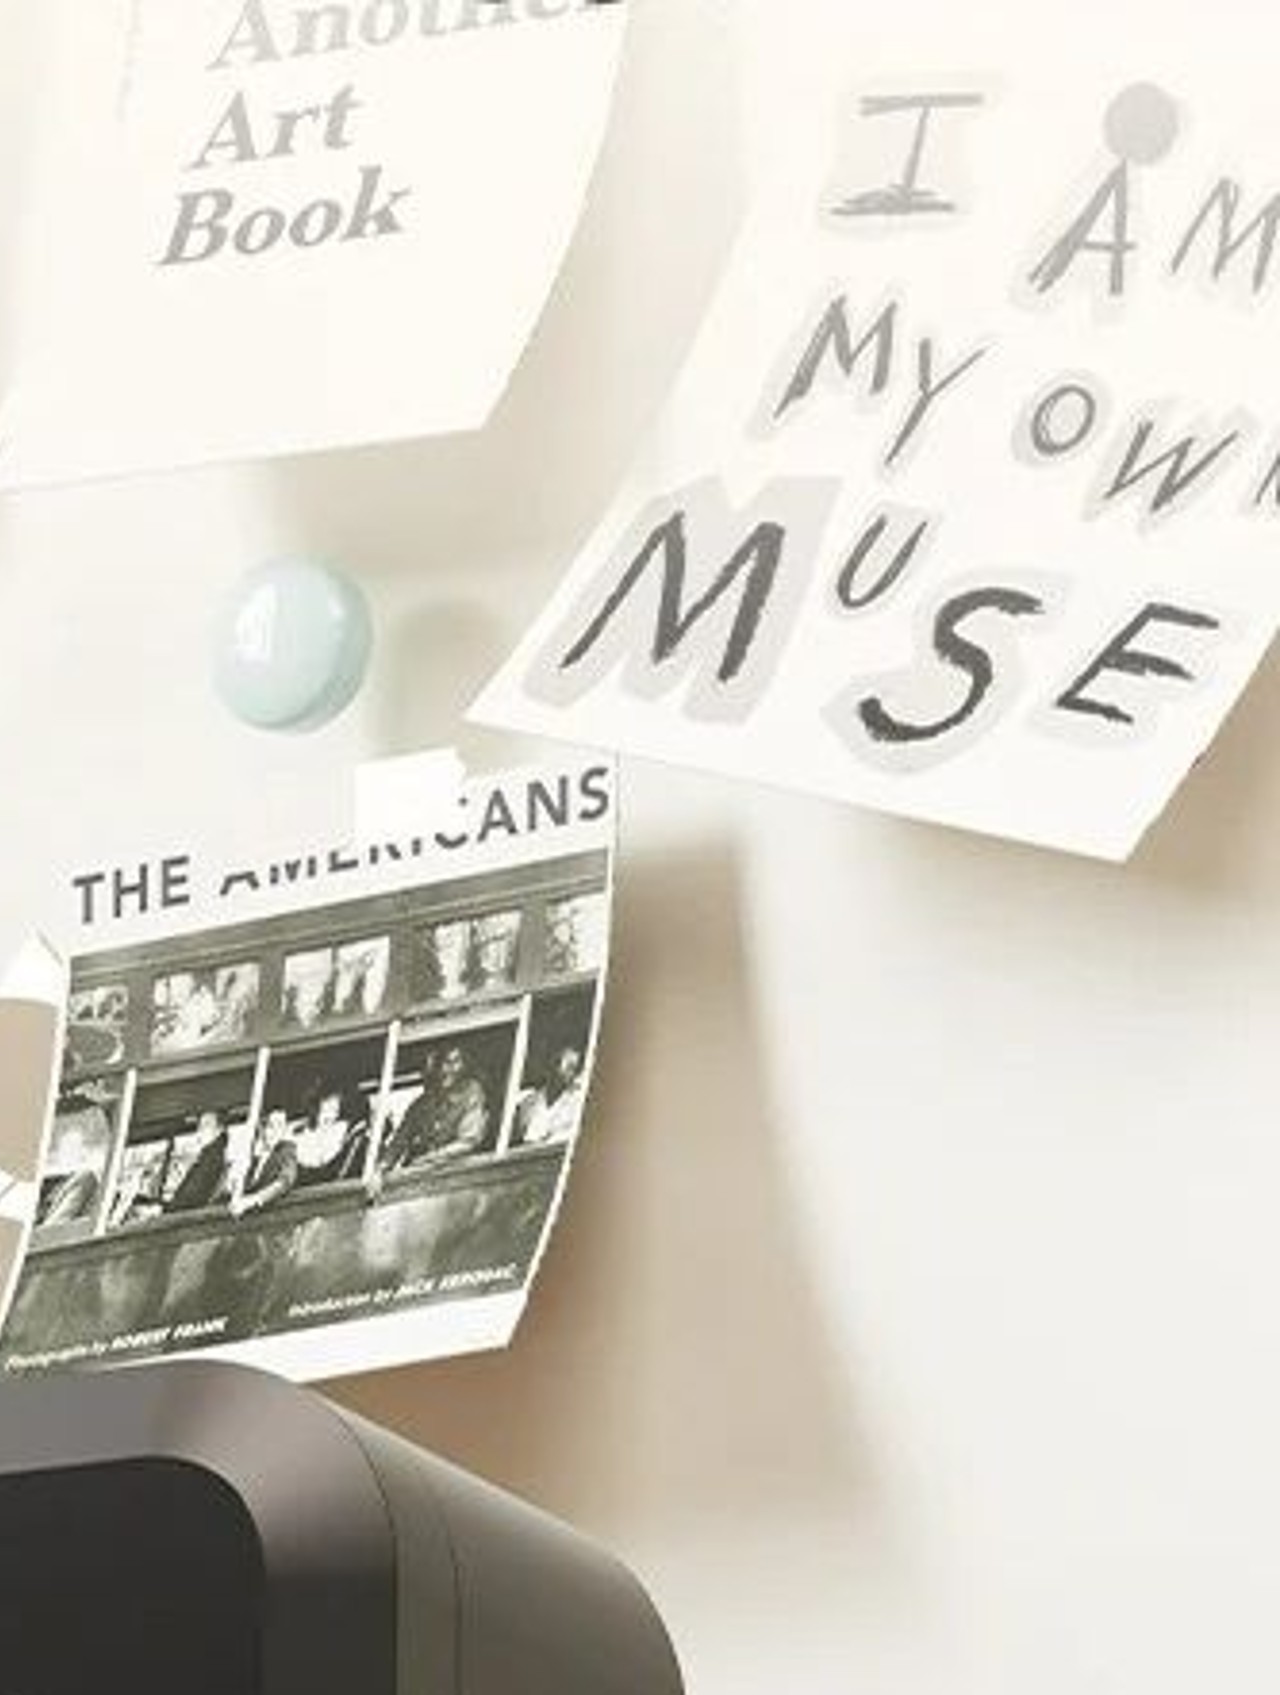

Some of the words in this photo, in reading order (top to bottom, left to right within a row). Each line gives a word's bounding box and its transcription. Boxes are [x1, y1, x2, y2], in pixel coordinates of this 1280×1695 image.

[205, 0, 605, 70] Anot
[182, 81, 368, 170] Art
[156, 166, 410, 266] Book
[830, 91, 985, 216] I
[1029, 156, 1280, 296] AM
[770, 294, 989, 468] MY
[556, 510, 1221, 744] MUSE
[72, 855, 193, 925] THE
